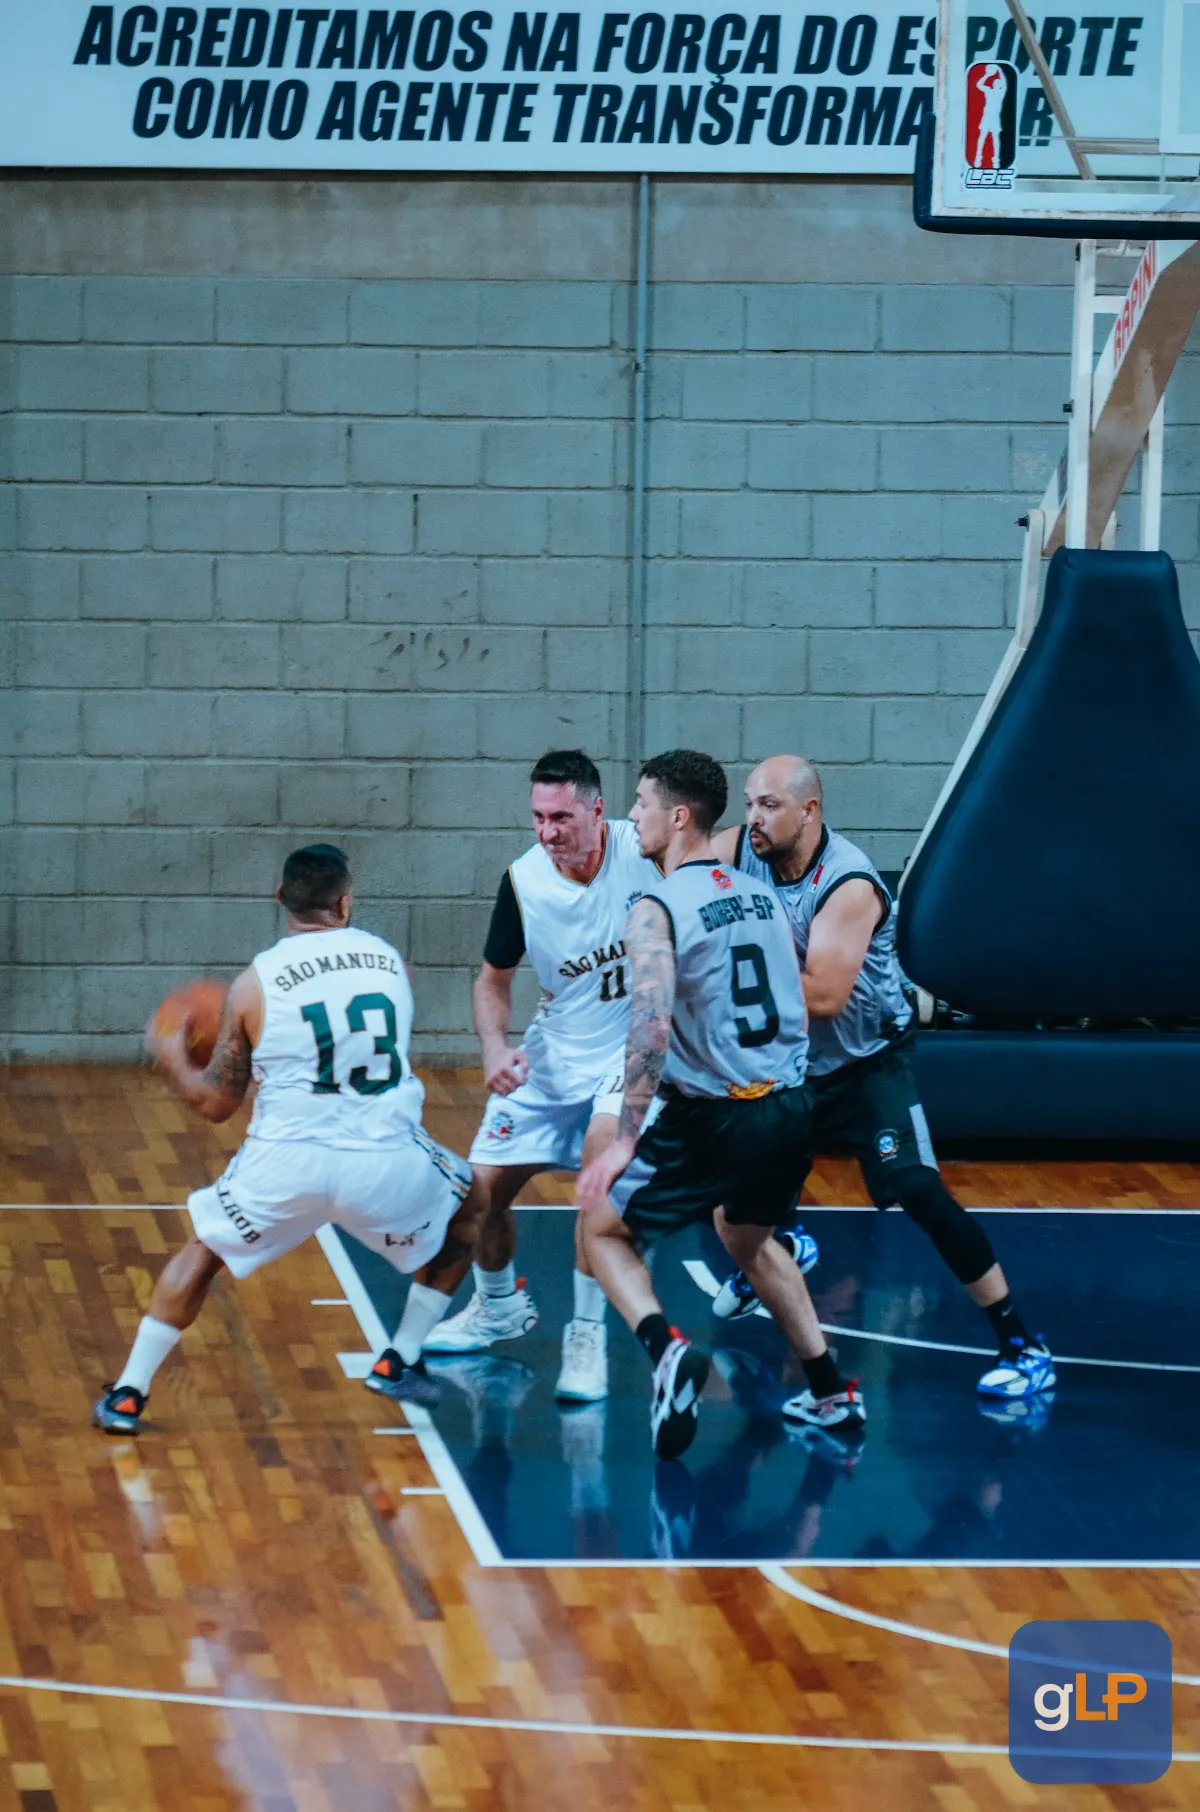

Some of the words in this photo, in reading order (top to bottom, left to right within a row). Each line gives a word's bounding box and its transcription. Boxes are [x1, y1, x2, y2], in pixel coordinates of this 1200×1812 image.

[72, 5, 493, 71] ACREDITAMOS
[502, 12, 581, 72] NA
[593, 12, 782, 86] FORÇA
[793, 14, 878, 76] DO
[132, 77, 309, 141] COMO
[315, 80, 540, 142] AGENTE
[553, 82, 1054, 147] TRANSFORMAR
[275, 961, 316, 992] SÃO
[315, 952, 399, 976] MANUEL
[600, 965, 628, 1002] 11
[728, 943, 780, 1049] 9
[300, 992, 402, 1096] 13
